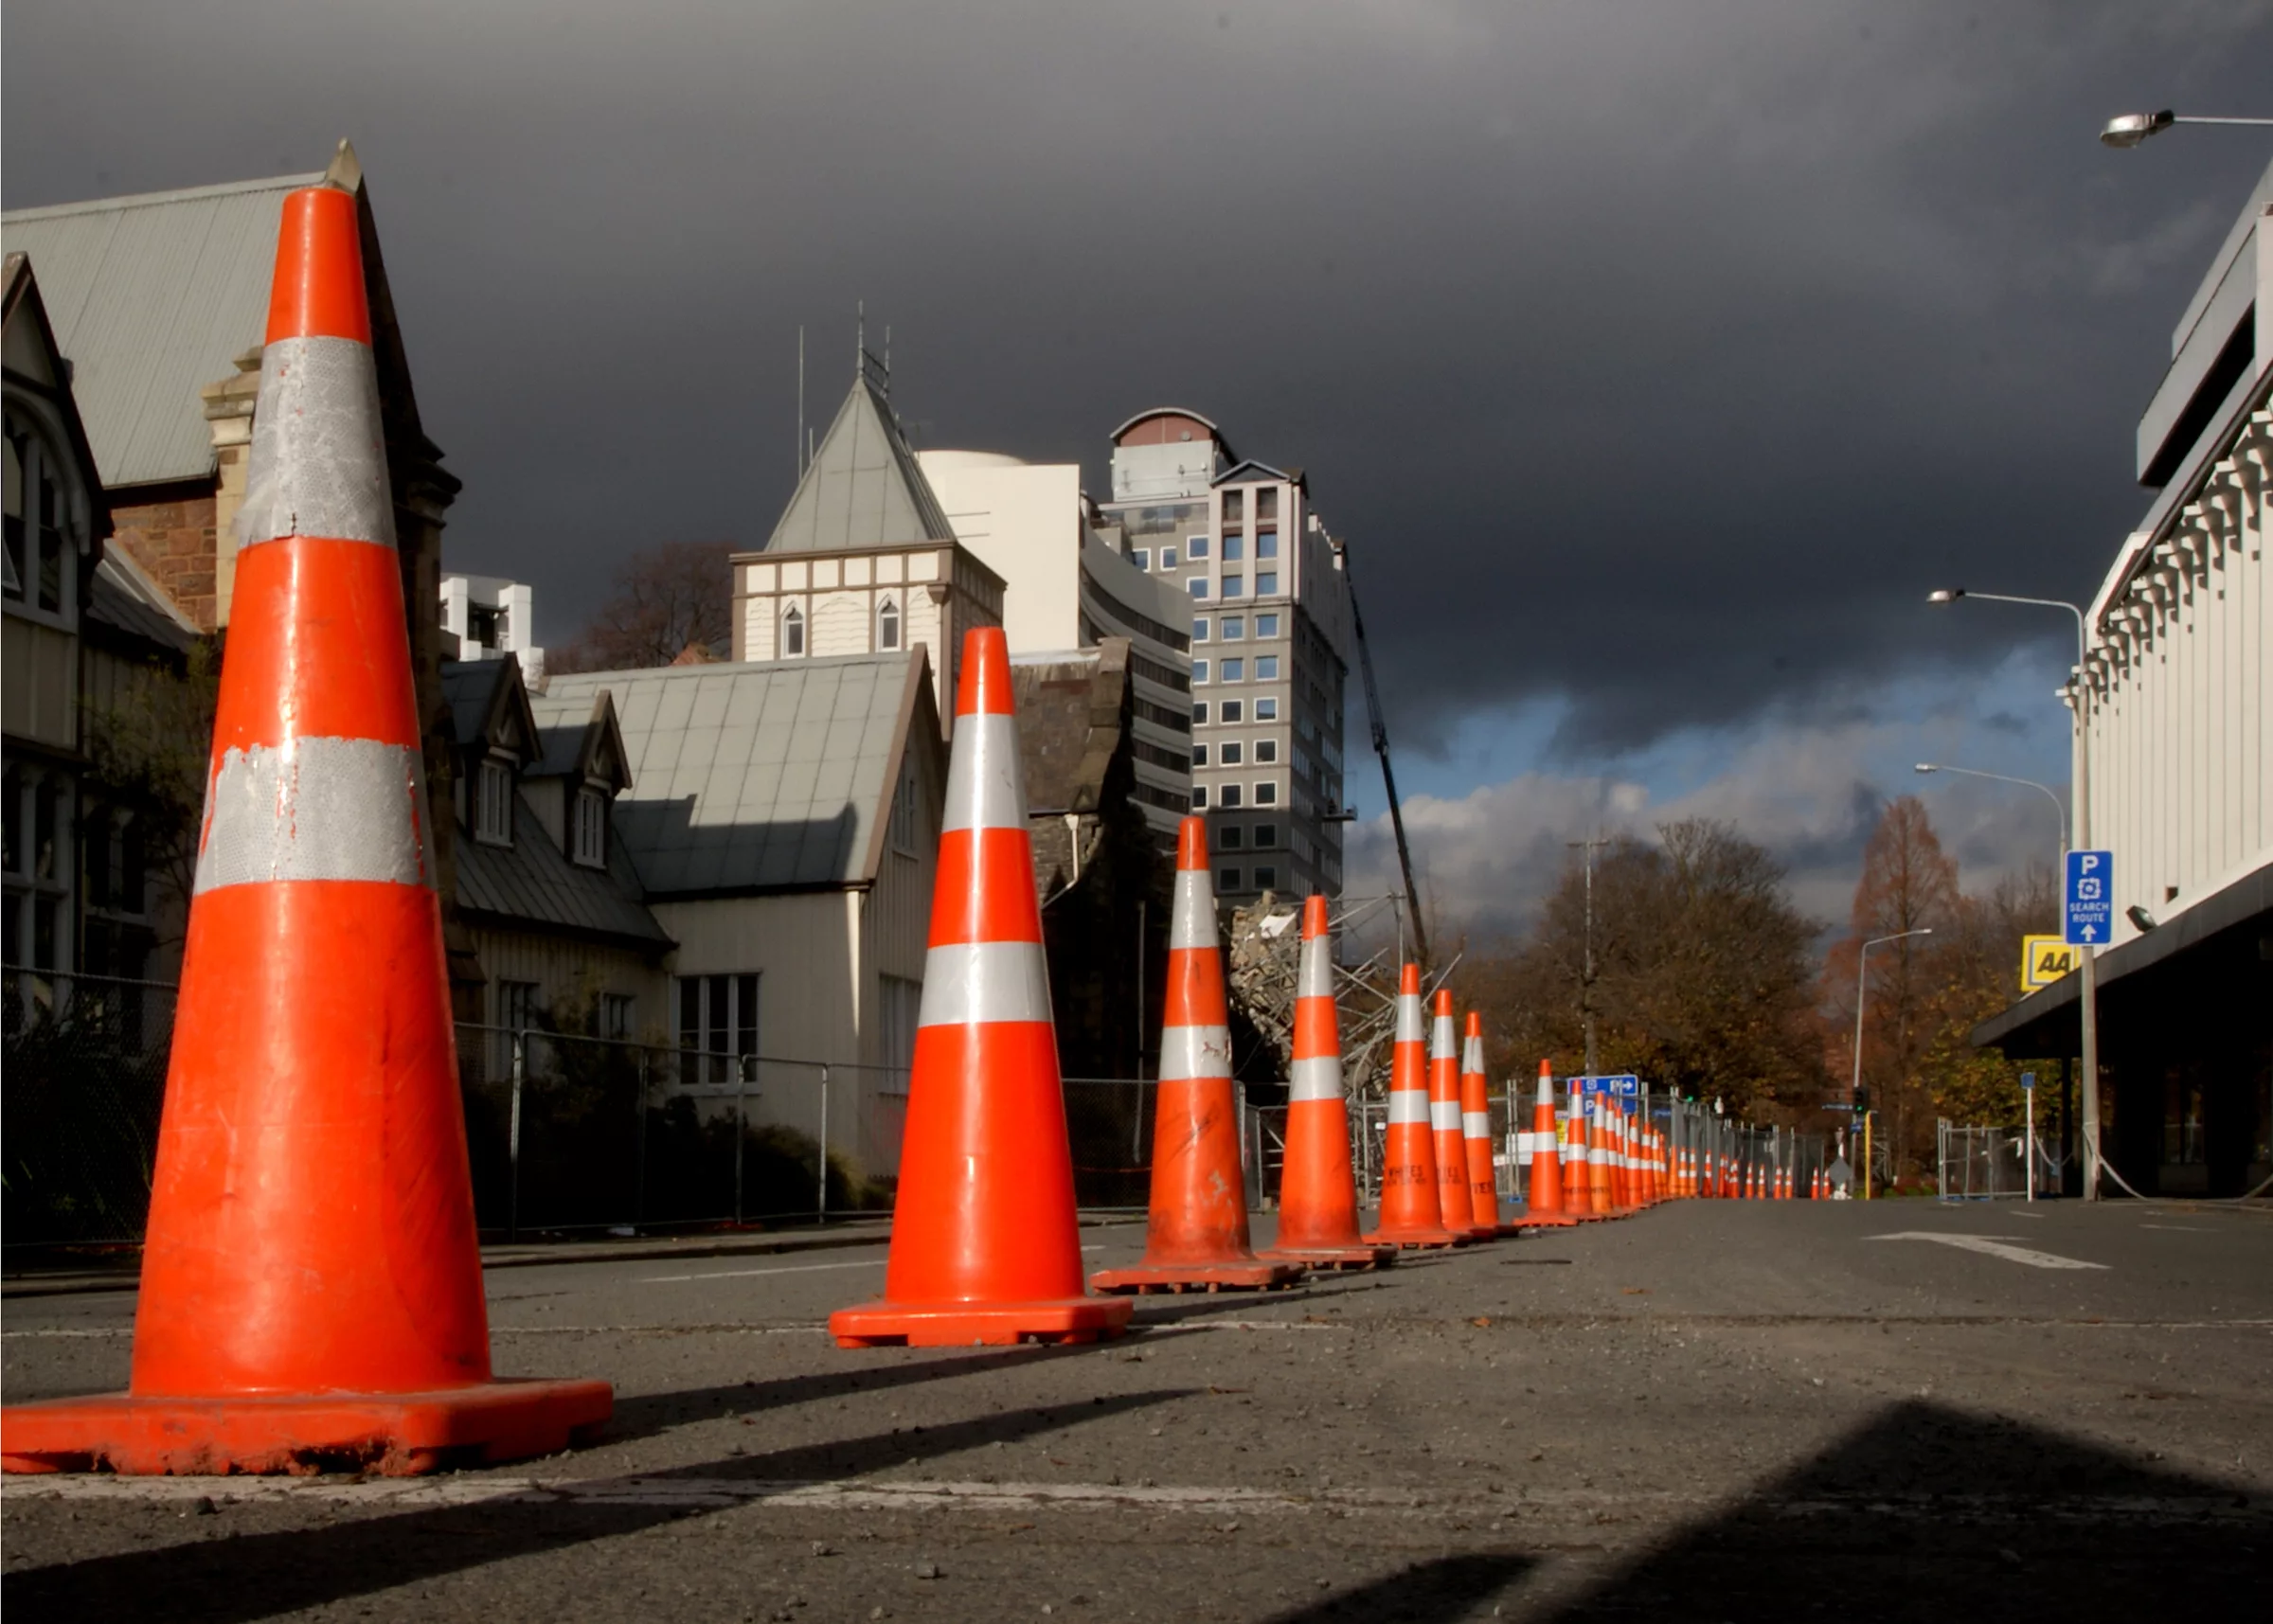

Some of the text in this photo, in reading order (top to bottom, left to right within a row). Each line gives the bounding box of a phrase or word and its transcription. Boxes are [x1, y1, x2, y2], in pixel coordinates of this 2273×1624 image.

[2081, 855, 2099, 876] P
[2069, 901, 2110, 912] SEARCH
[2072, 912, 2105, 923] ROUTE
[2037, 952, 2070, 973] AA
